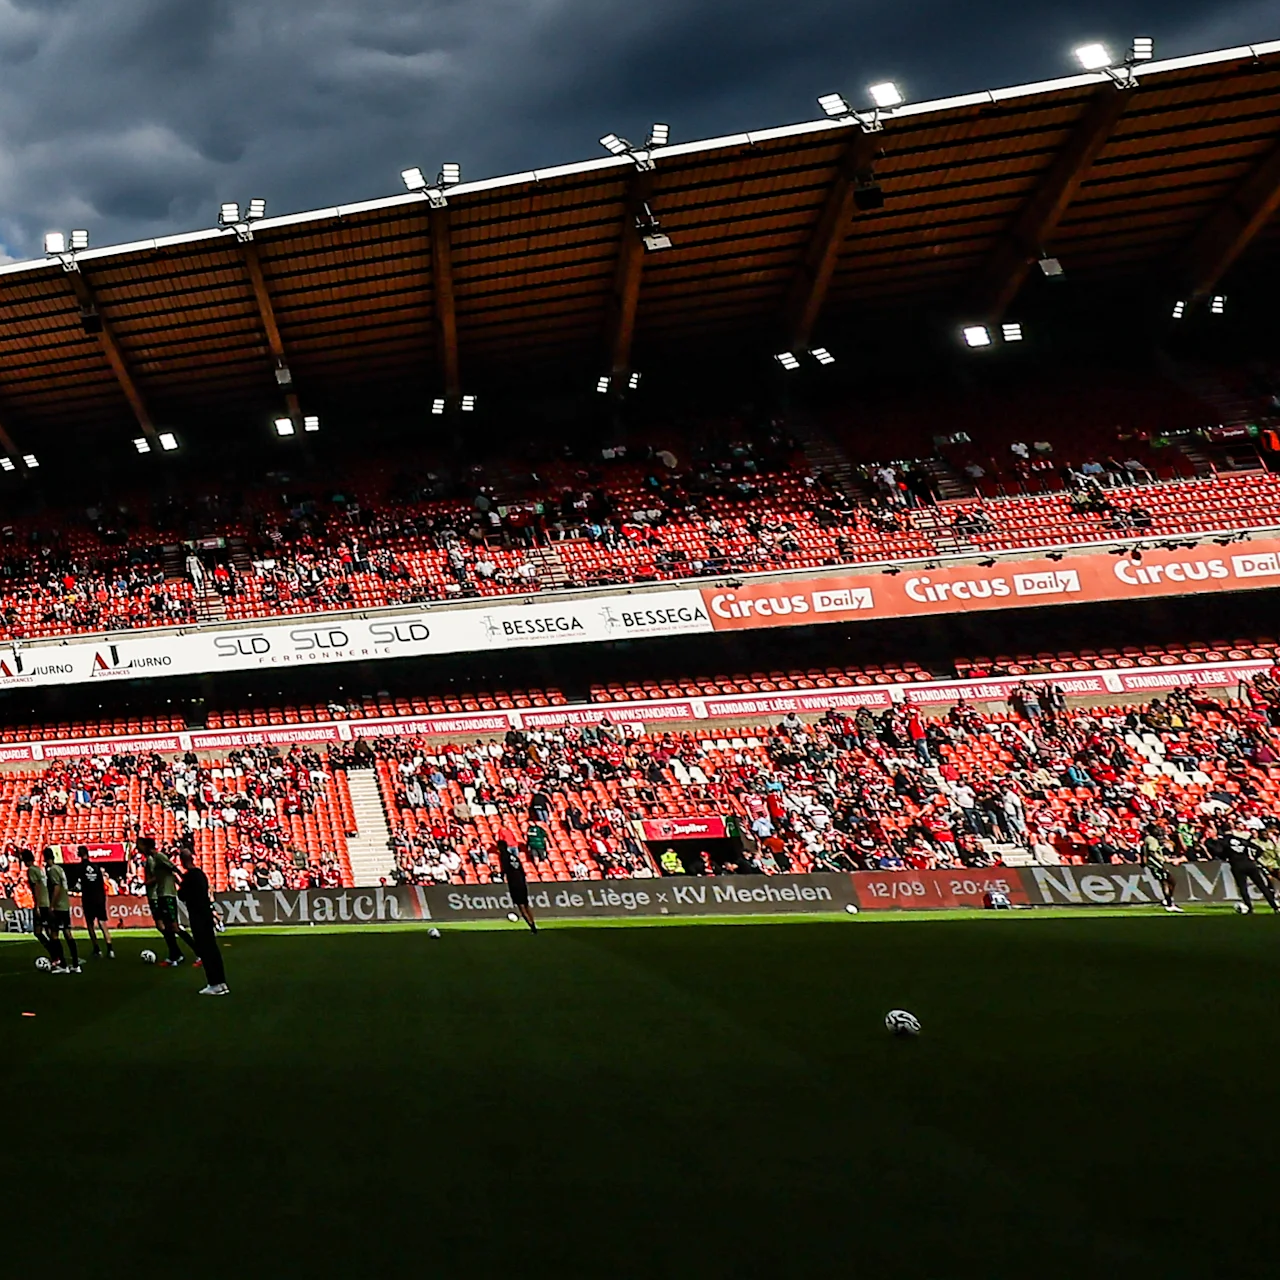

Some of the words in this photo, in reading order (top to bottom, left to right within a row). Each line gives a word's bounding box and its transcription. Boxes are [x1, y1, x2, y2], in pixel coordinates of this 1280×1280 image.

[1113, 556, 1230, 585] Circus
[904, 576, 1011, 603] Circus
[1022, 570, 1071, 592] Daily
[710, 592, 810, 619] Circus
[820, 591, 866, 610] Daily
[502, 615, 584, 636] BESSEGA
[621, 606, 708, 627] BESSEGA
[213, 633, 271, 657] SLD
[290, 626, 349, 651] SLD
[368, 619, 430, 645] SLD
[258, 647, 391, 664] FERRONNERIE
[1125, 673, 1179, 688] STANDARD
[1179, 671, 1194, 684] DE
[910, 686, 960, 701] STANDARD
[961, 685, 976, 698] DE
[709, 700, 756, 714] STANDARD
[757, 699, 770, 710] DE
[525, 713, 567, 725] STANDARD
[568, 712, 580, 722] DE
[194, 735, 231, 747] STANDARD
[232, 734, 241, 744] DE
[353, 724, 394, 736] STANDARD
[394, 724, 405, 733] DE
[45, 744, 80, 756] STANDARD
[80, 744, 90, 753] DE
[555, 889, 584, 908] de
[588, 888, 651, 914] Liège
[675, 885, 706, 904] KV
[713, 883, 833, 903] Mechelen
[867, 879, 926, 899] 12/09
[950, 878, 1011, 897] 20:45
[273, 886, 402, 922] Match
